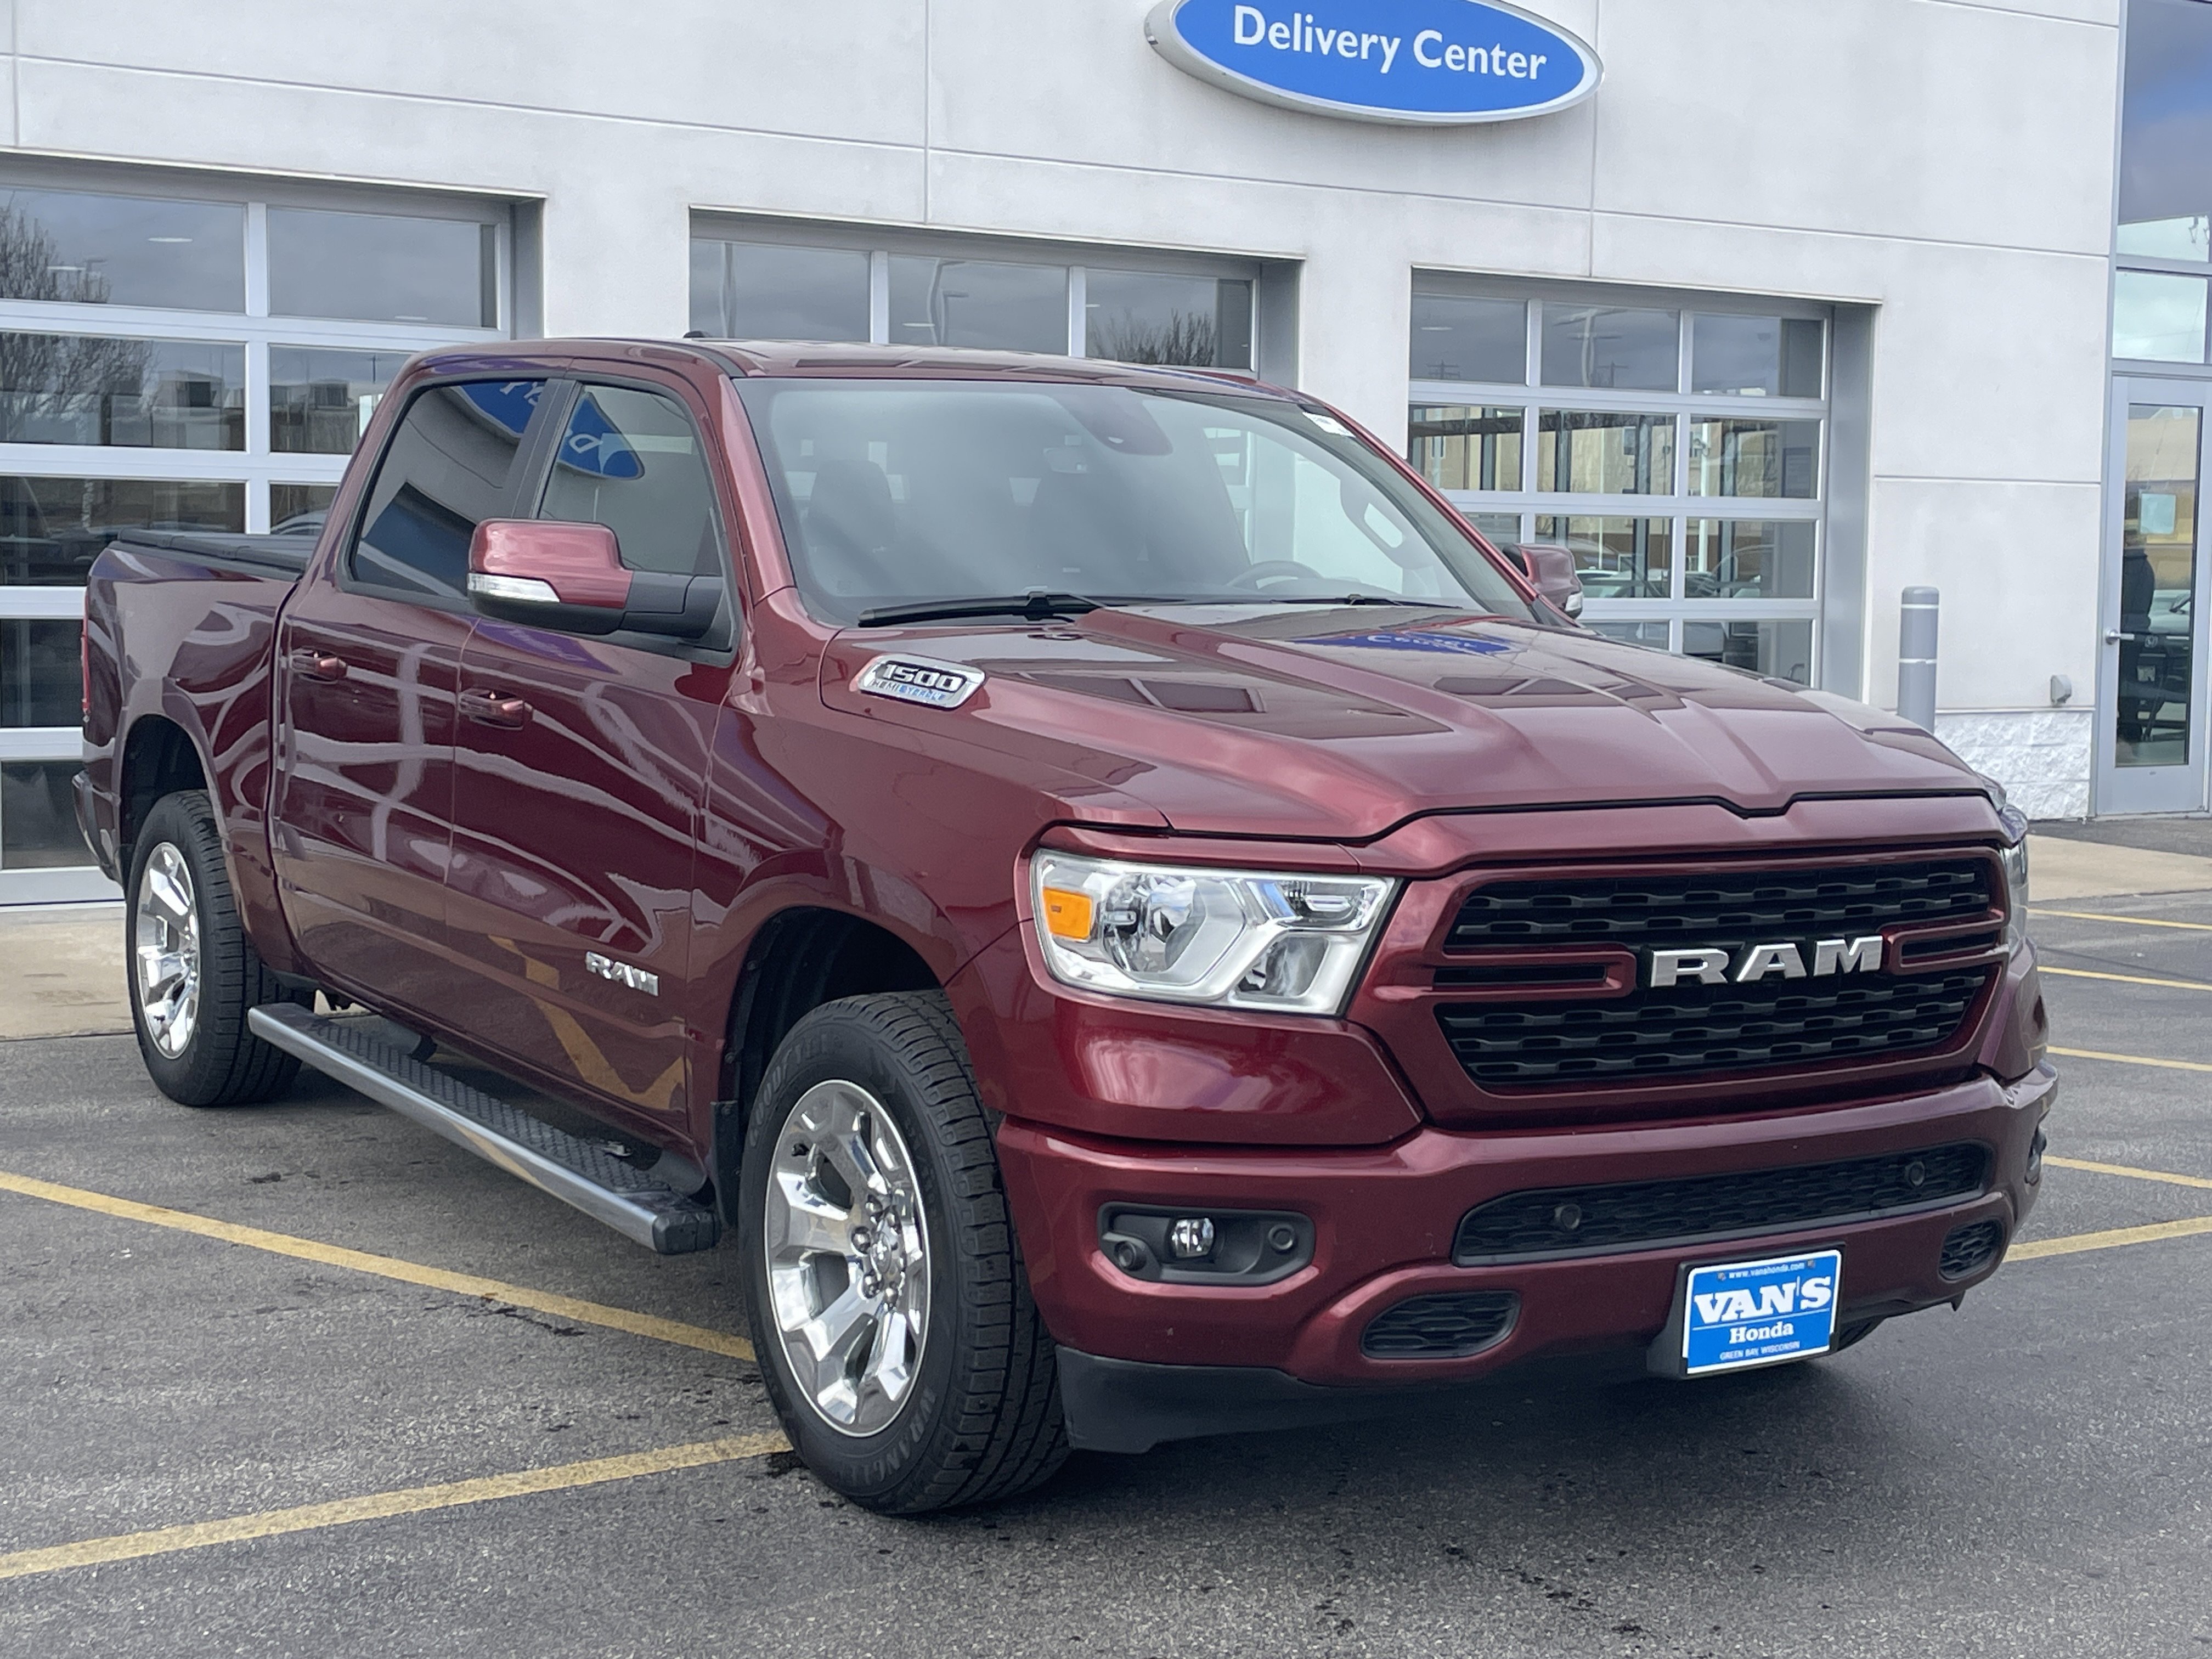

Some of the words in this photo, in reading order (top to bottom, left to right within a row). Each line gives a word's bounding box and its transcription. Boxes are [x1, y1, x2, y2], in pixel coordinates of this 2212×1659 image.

[1233, 5, 1401, 74] Delivery
[1413, 30, 1548, 80] Center
[883, 664, 964, 692] 1500
[585, 951, 659, 996] RAM
[1651, 935, 1883, 988] RAM
[1694, 1276, 1831, 1324] VAN'S
[1719, 1350, 1744, 1361] GREEN
[1760, 1341, 1801, 1355] WISCONSIN
[1729, 1321, 1794, 1344] Honda
